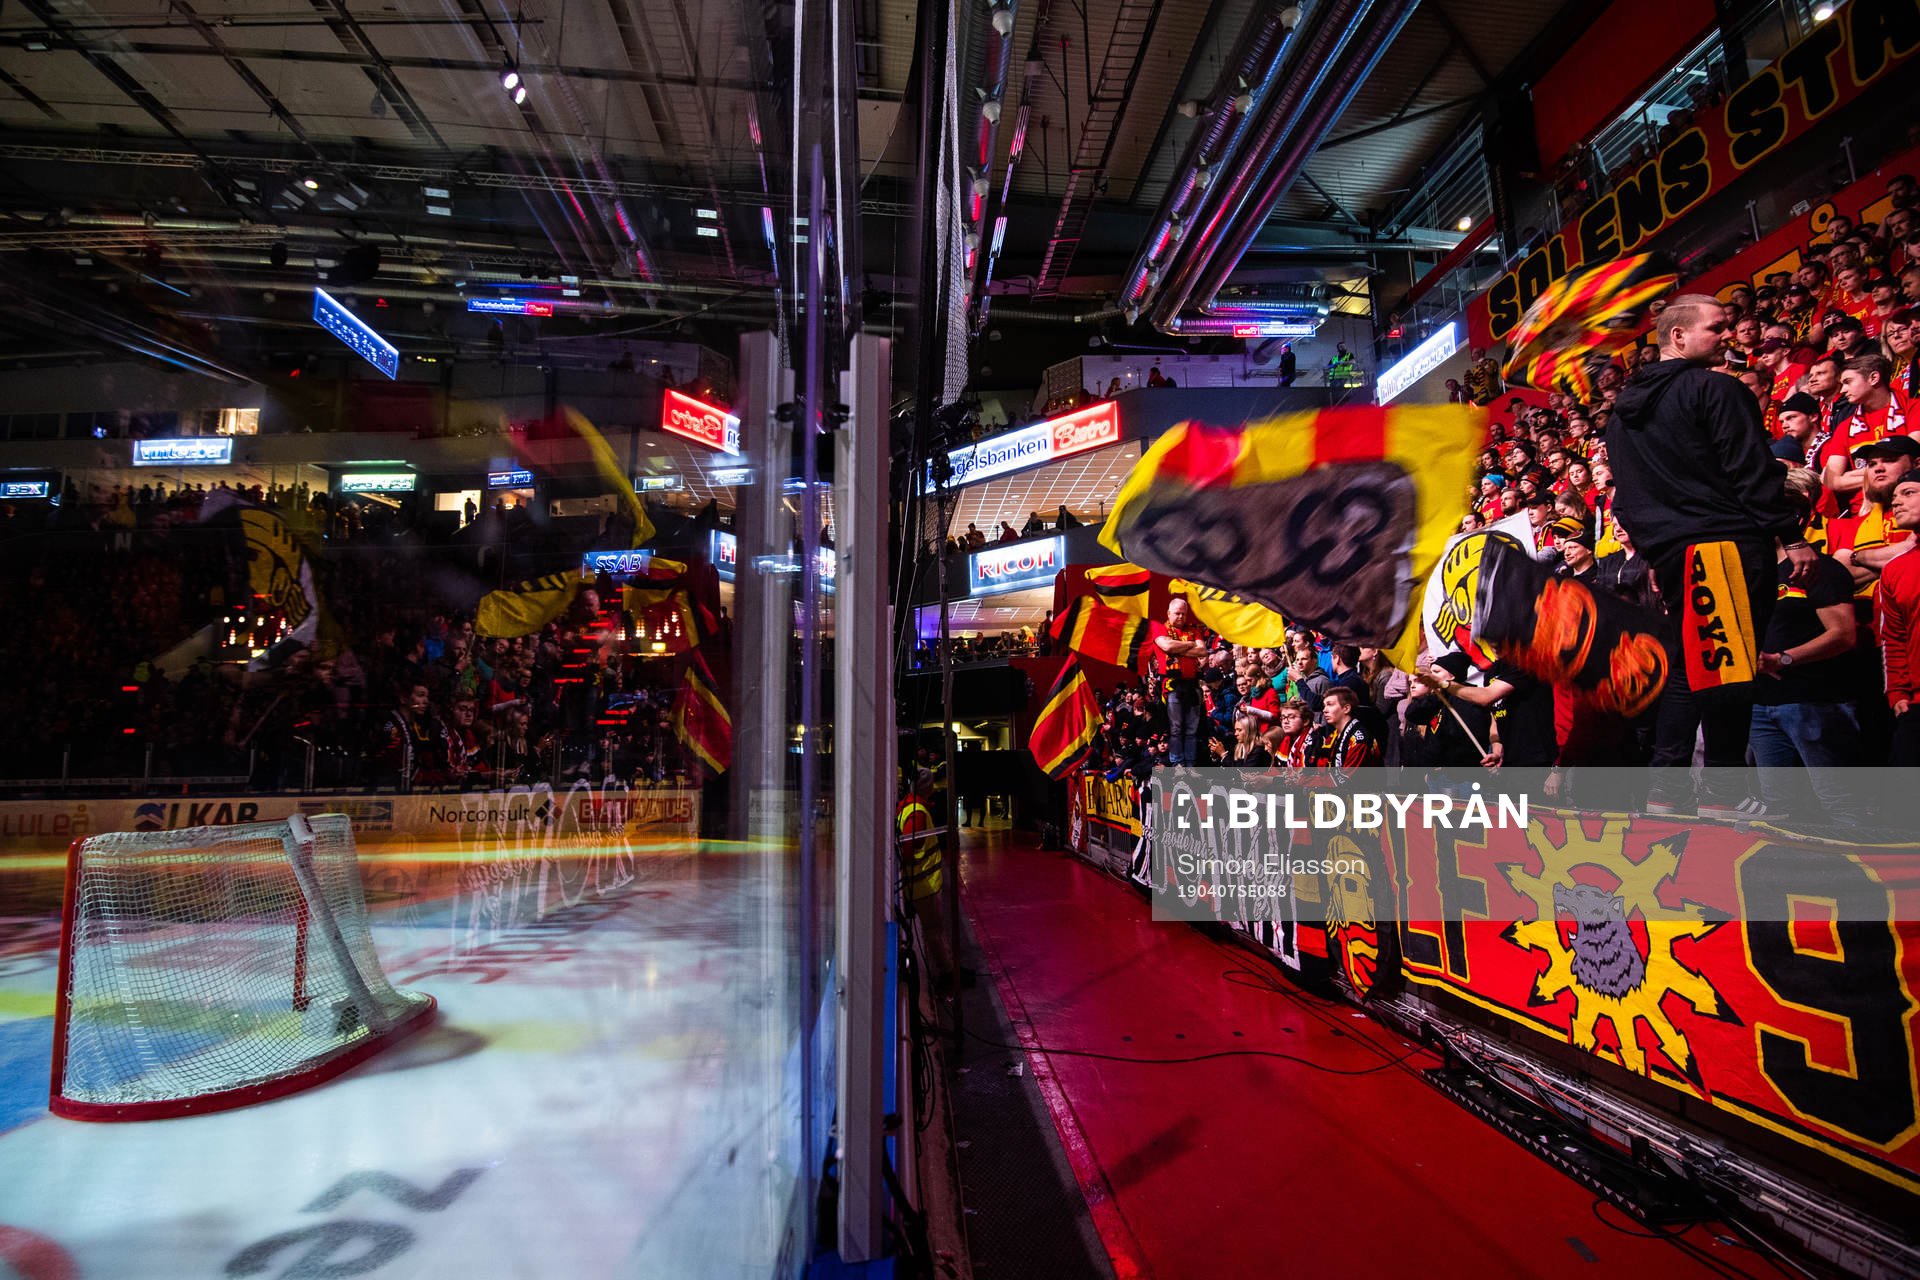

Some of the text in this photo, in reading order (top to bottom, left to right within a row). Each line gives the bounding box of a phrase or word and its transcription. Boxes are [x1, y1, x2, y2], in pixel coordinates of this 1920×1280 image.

[1054, 419, 1111, 449] Bistro
[594, 553, 642, 574] SSAB
[978, 552, 1055, 580] RICOH
[1690, 550, 1735, 672] BOYS
[429, 804, 529, 824] Norconsult
[581, 799, 691, 821] BAUHAUS
